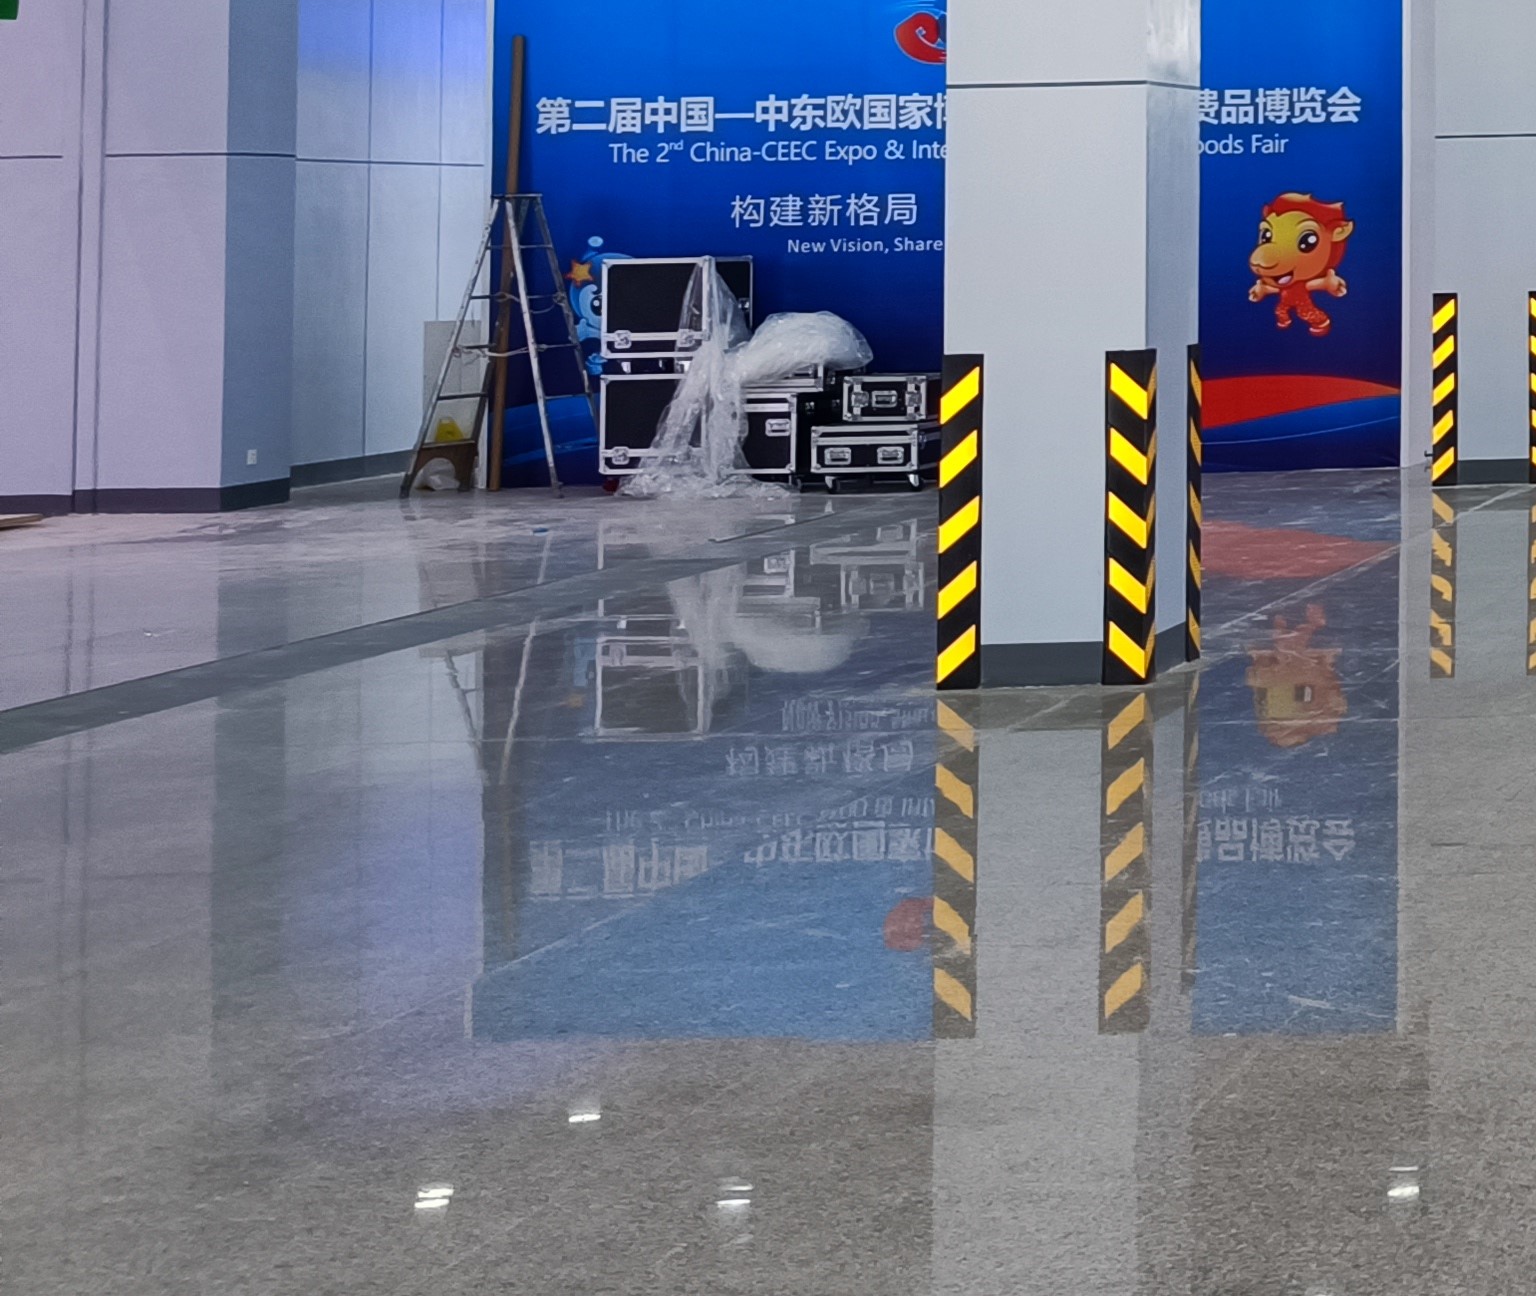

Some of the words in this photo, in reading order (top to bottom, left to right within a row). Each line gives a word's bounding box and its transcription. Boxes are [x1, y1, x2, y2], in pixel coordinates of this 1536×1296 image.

[609, 143, 649, 164] The
[657, 140, 684, 164] 2nd
[690, 141, 817, 163] China-CEEC
[825, 140, 877, 166] Expo
[885, 140, 905, 161] &
[1251, 132, 1289, 154] Fair
[730, 193, 918, 229] 构建新格局
[788, 240, 826, 254] New
[830, 238, 889, 255] Vision,
[894, 237, 944, 253] Share
